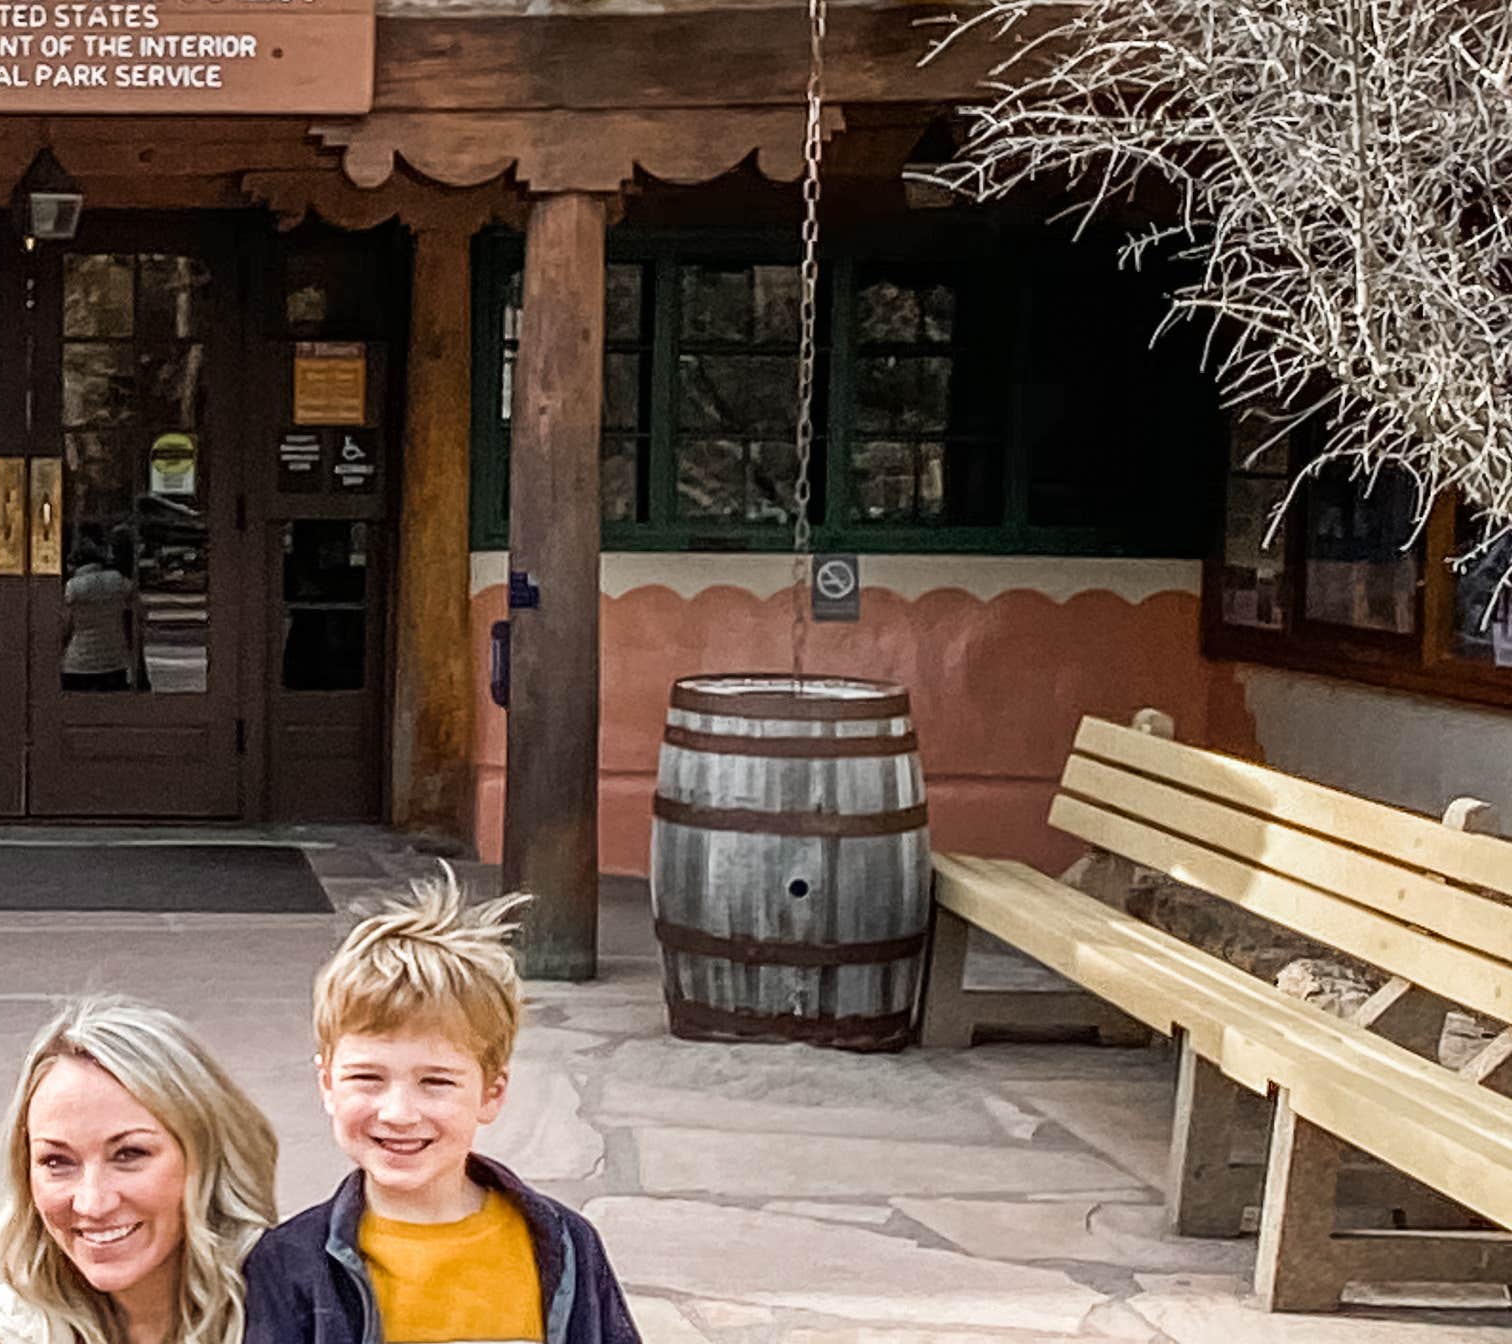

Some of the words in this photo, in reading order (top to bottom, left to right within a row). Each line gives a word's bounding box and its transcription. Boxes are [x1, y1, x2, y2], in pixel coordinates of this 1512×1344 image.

[54, 4, 159, 29] STATES
[40, 35, 75, 58] OF
[83, 35, 133, 58] THE
[139, 35, 257, 58] INTERIOR
[35, 64, 108, 87] PARK
[115, 64, 222, 88] SERVICE
